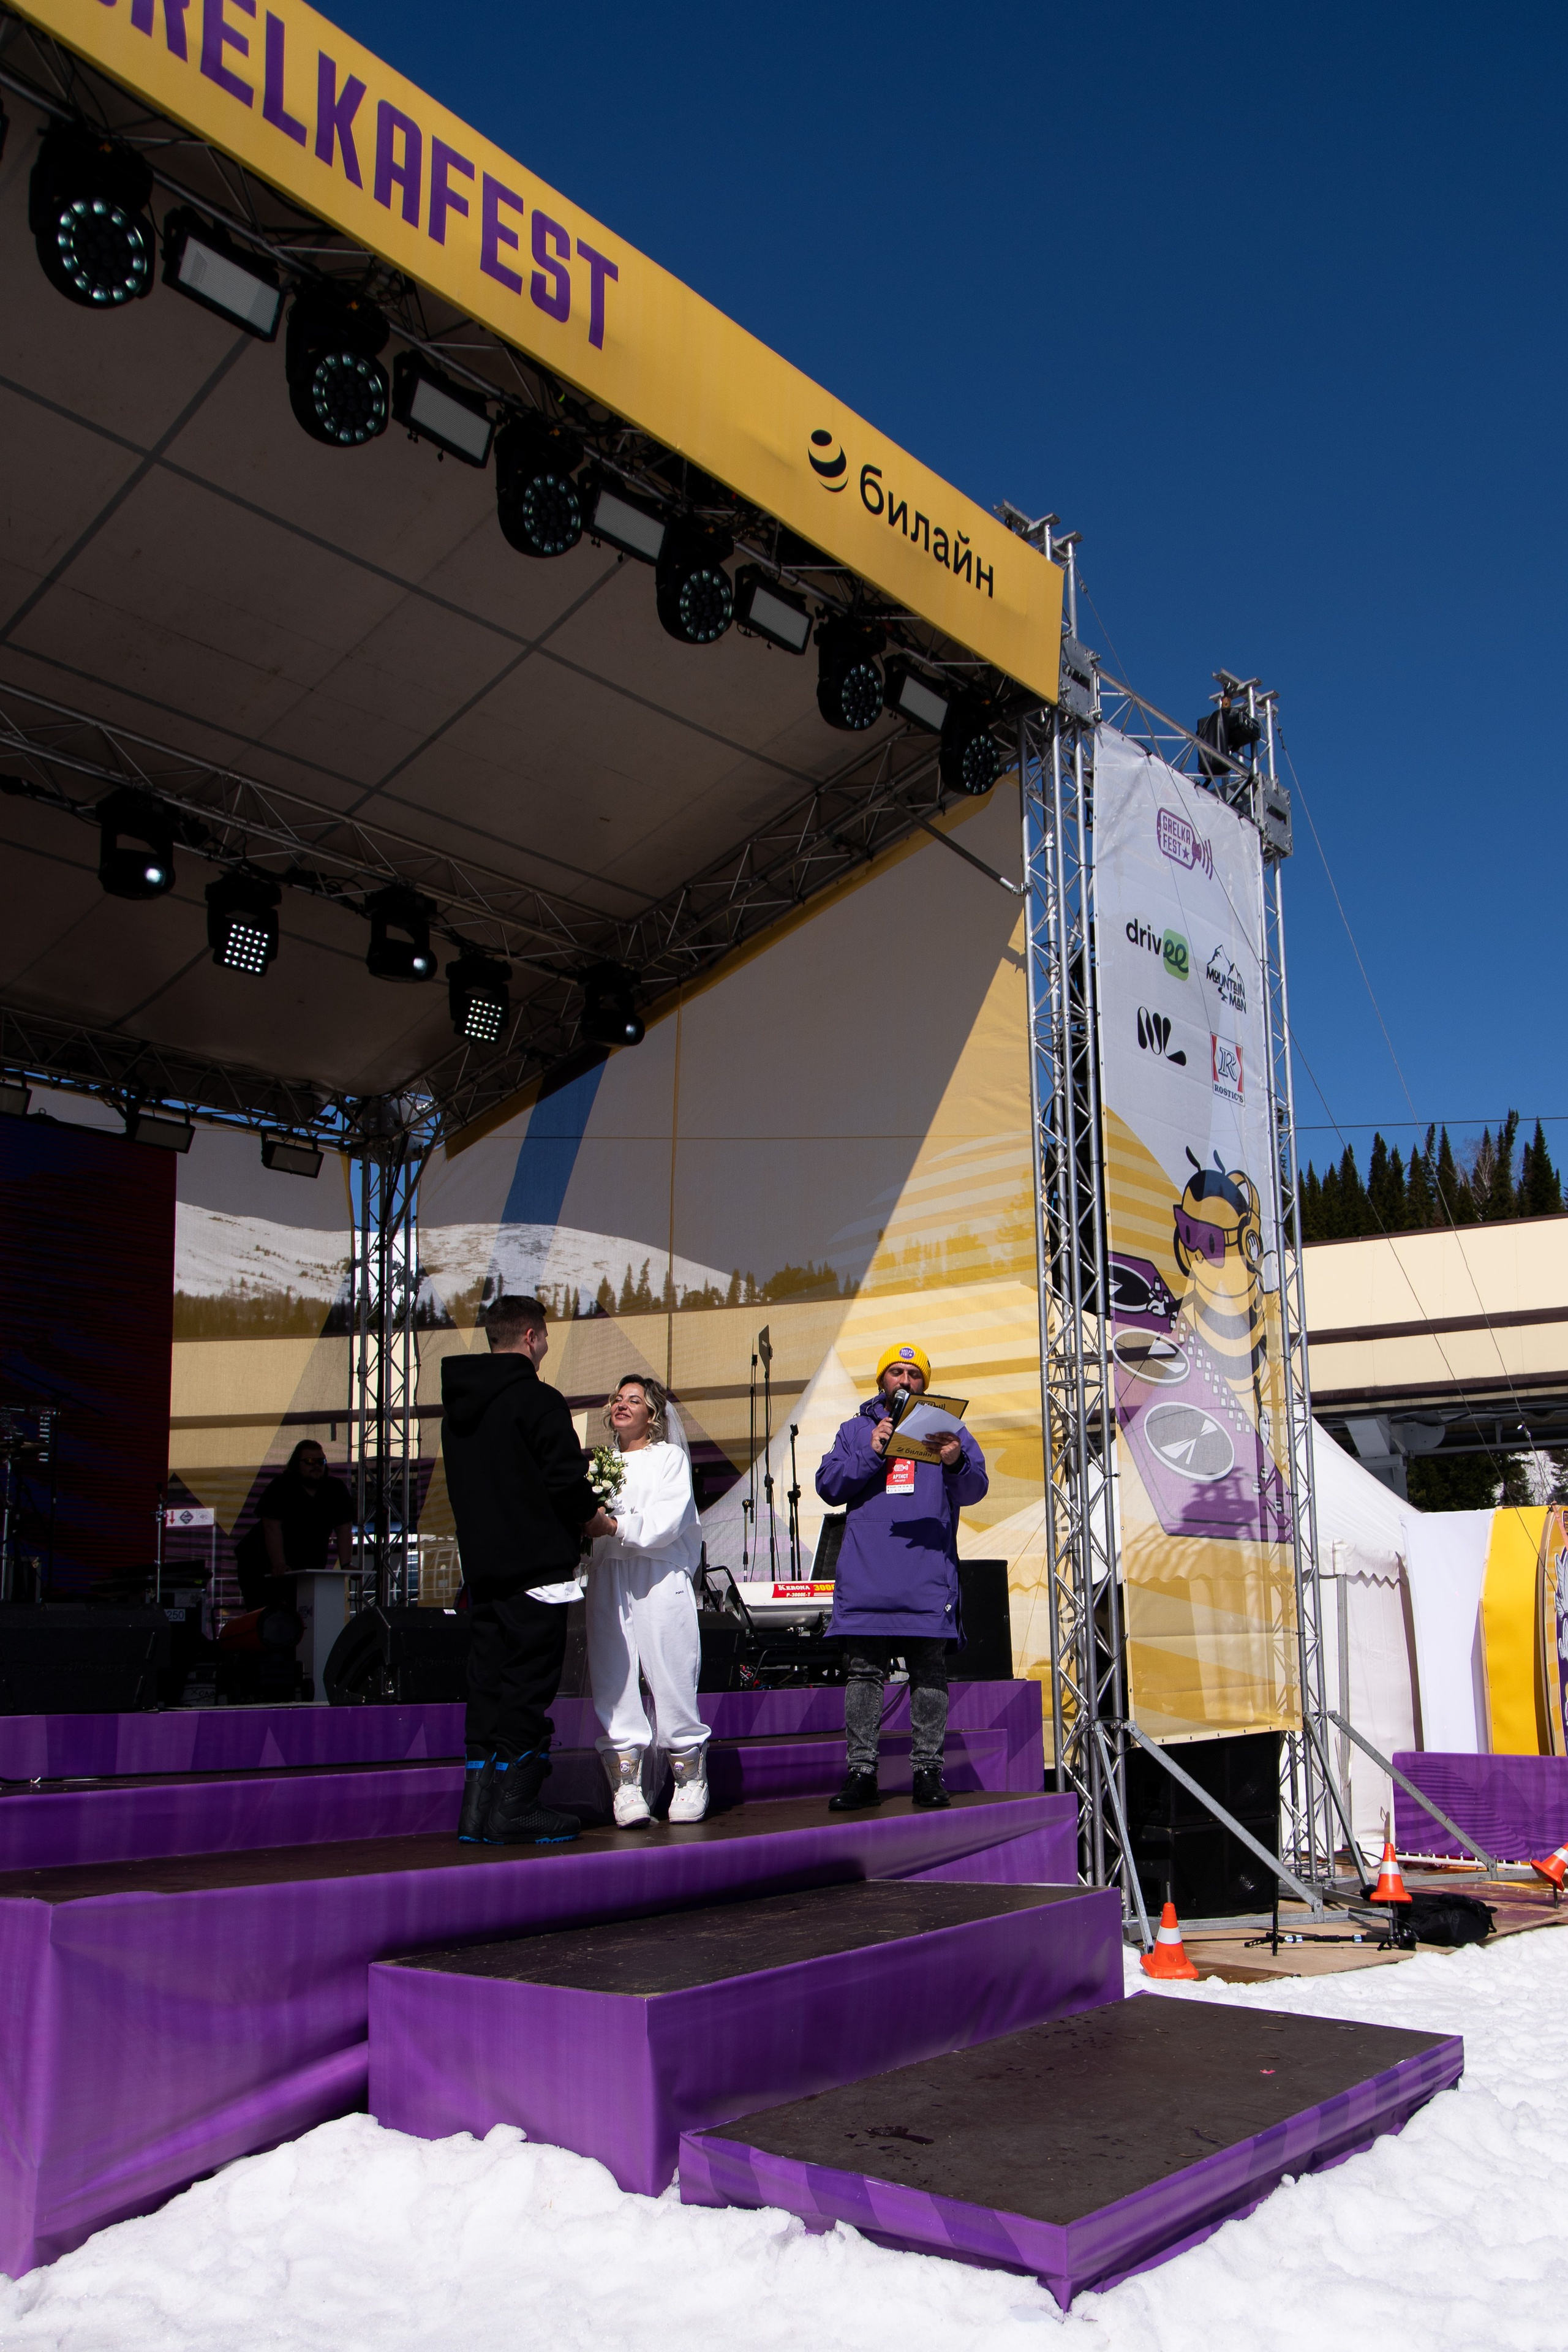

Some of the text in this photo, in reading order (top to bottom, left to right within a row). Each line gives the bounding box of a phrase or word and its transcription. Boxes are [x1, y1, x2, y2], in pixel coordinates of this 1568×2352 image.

[97, 0, 619, 350] ELKAFEST
[859, 463, 994, 598] билайн
[1163, 815, 1191, 845] GRELKA
[1163, 832, 1182, 856] FEST
[1126, 918, 1189, 973] drivee
[1207, 965, 1245, 999] MOUNTAIN
[1229, 992, 1246, 1014] MAN
[1214, 1084, 1243, 1103] ROSTIC'S
[905, 1447, 933, 1458] билайн
